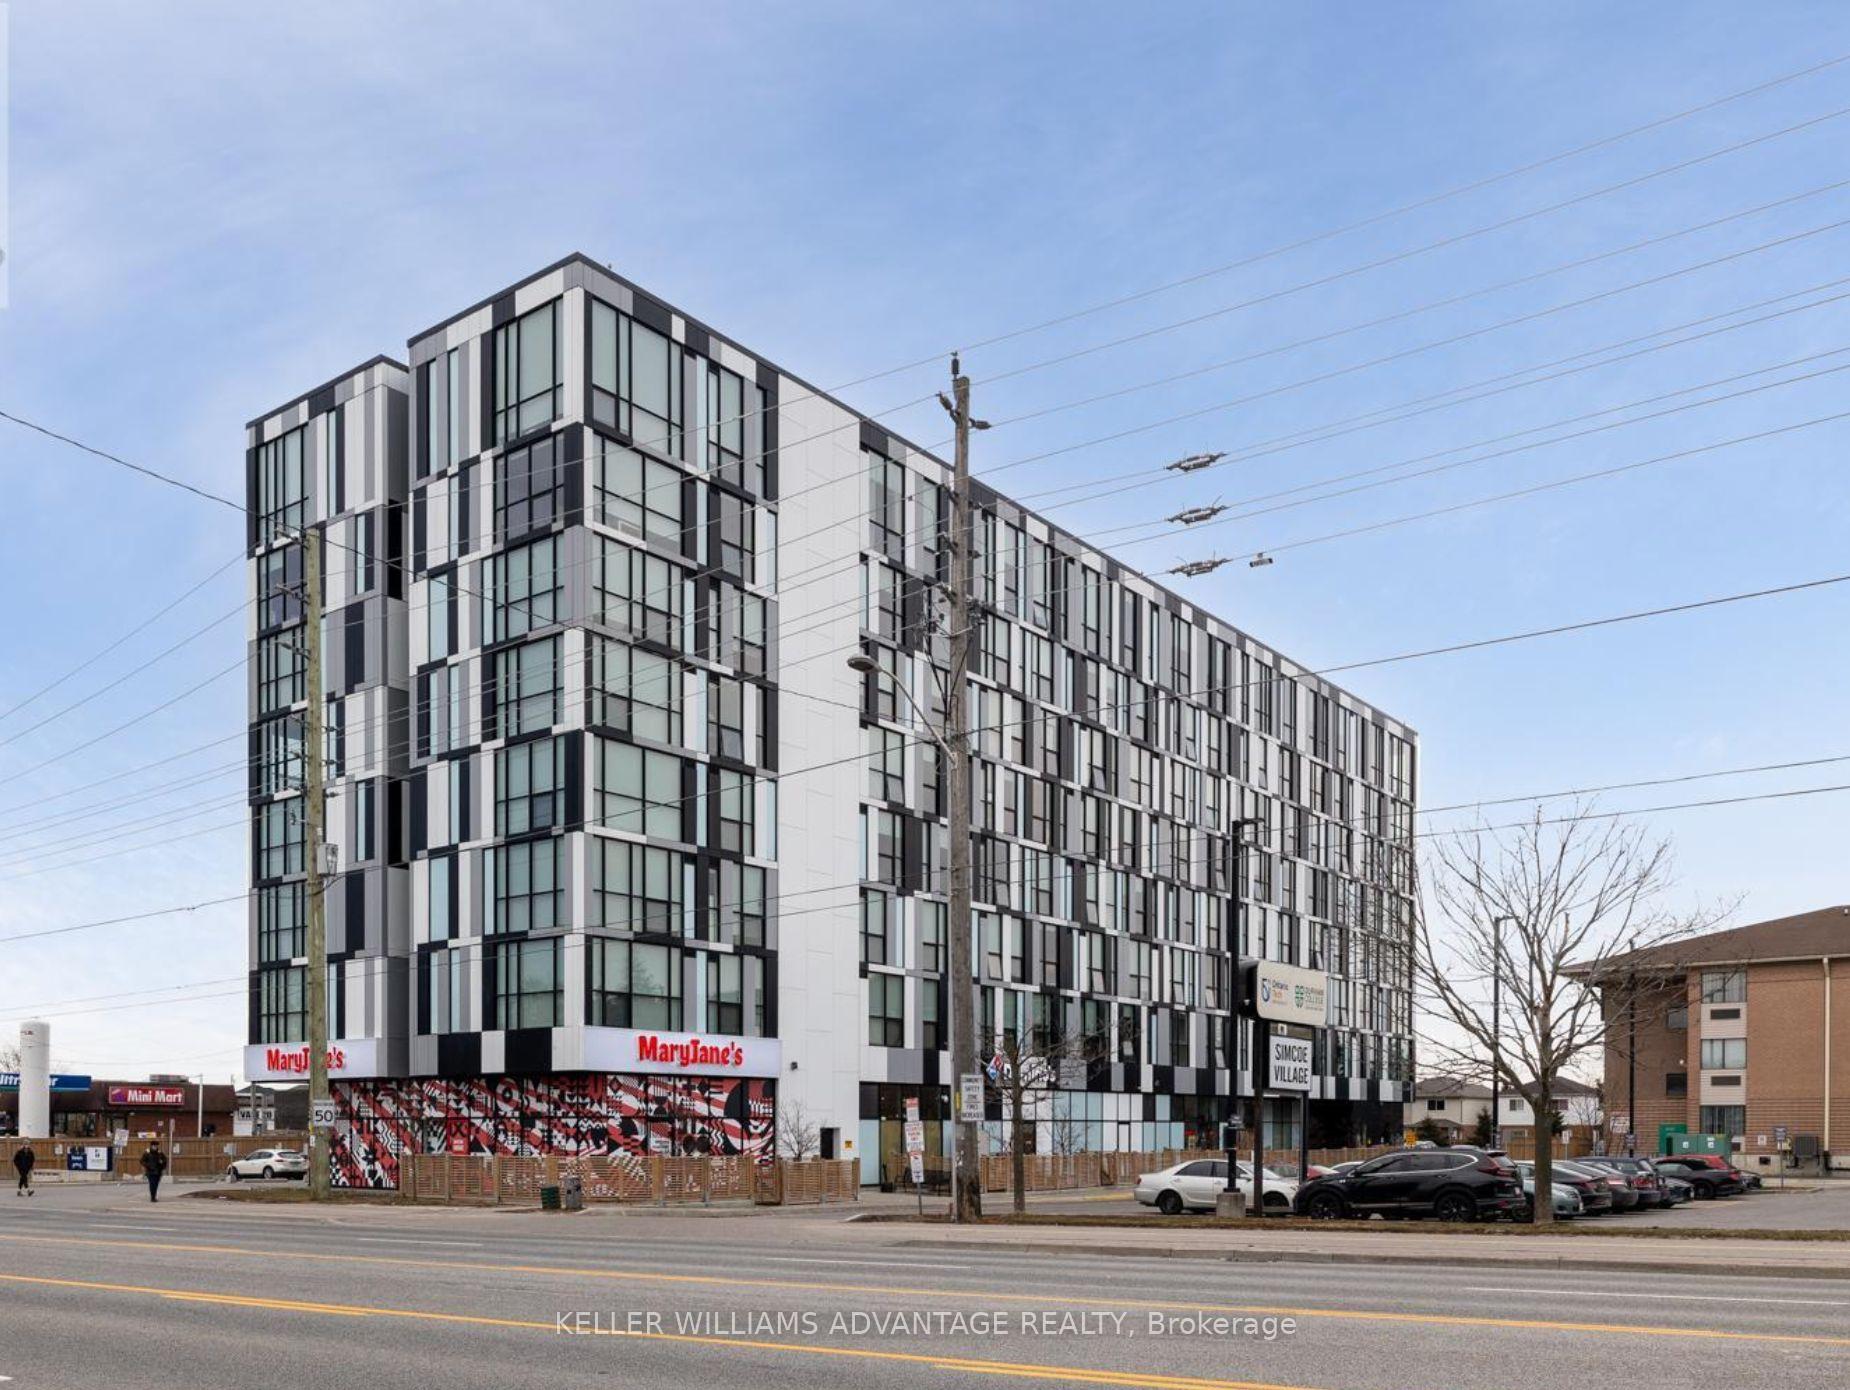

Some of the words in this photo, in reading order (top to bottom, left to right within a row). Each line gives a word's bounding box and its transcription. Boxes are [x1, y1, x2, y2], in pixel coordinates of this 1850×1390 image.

[267, 1047, 344, 1073] MaryJe's
[638, 1035, 743, 1067] MaryJane's
[1274, 1043, 1308, 1063] SIMCOE
[1274, 1065, 1308, 1084] VILLAGE
[128, 1088, 152, 1103] Mini
[154, 1089, 183, 1103] Mart
[315, 1109, 334, 1122] 50
